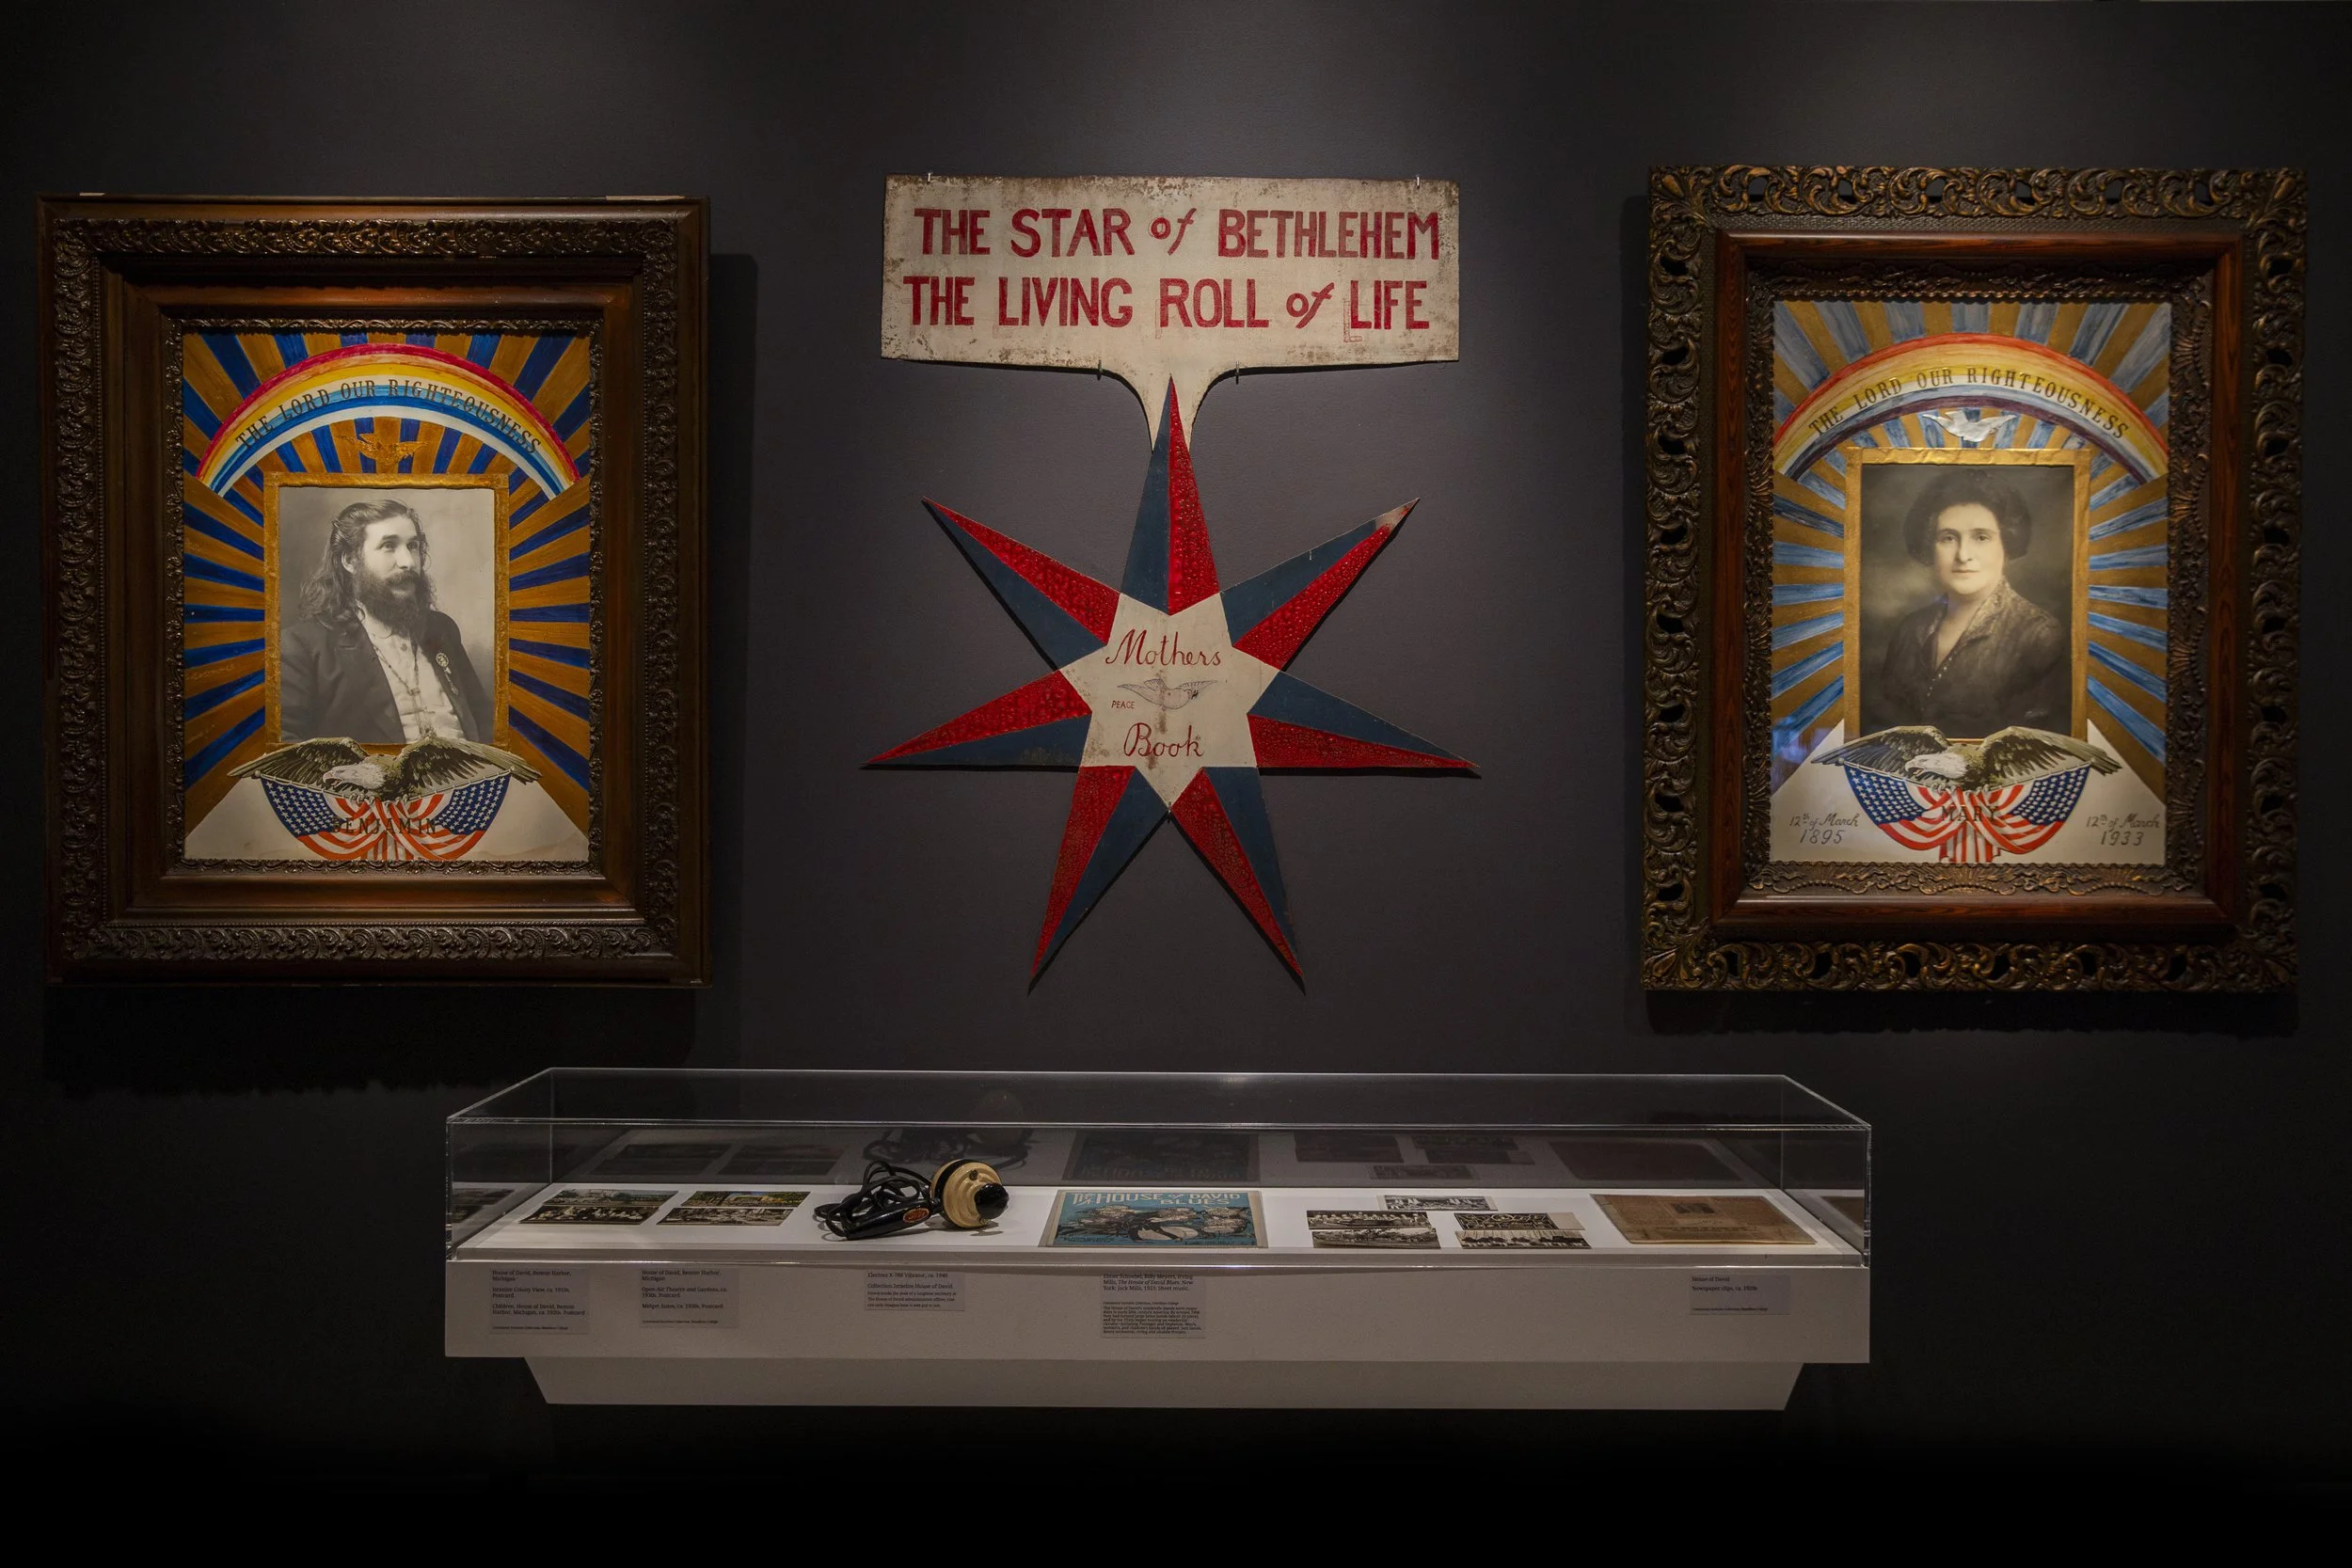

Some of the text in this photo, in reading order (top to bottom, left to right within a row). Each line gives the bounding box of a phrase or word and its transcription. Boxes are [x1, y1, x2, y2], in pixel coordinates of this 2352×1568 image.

[914, 208, 1439, 260] THE STAR of BETHLEHEM
[903, 276, 1430, 329] THE LIVING ROLL of LIFE
[1808, 367, 2129, 439] THE LORD OUR RIGHTEOUSNESS
[235, 379, 542, 454] THE LORD OUR RIGHTEOUSNESS
[1105, 629, 1222, 666] Mothers
[1111, 700, 1135, 709] PEACE
[1123, 722, 1204, 757] Book
[1941, 805, 1999, 821] MARY
[2119, 813, 2160, 828] March
[331, 817, 437, 834] BENJAMIN
[1810, 816, 1819, 831] of
[1819, 813, 1859, 827] March
[1799, 829, 1846, 845] 1895
[2101, 831, 2144, 846] 1933
[1096, 1193, 1164, 1204] HOUSE
